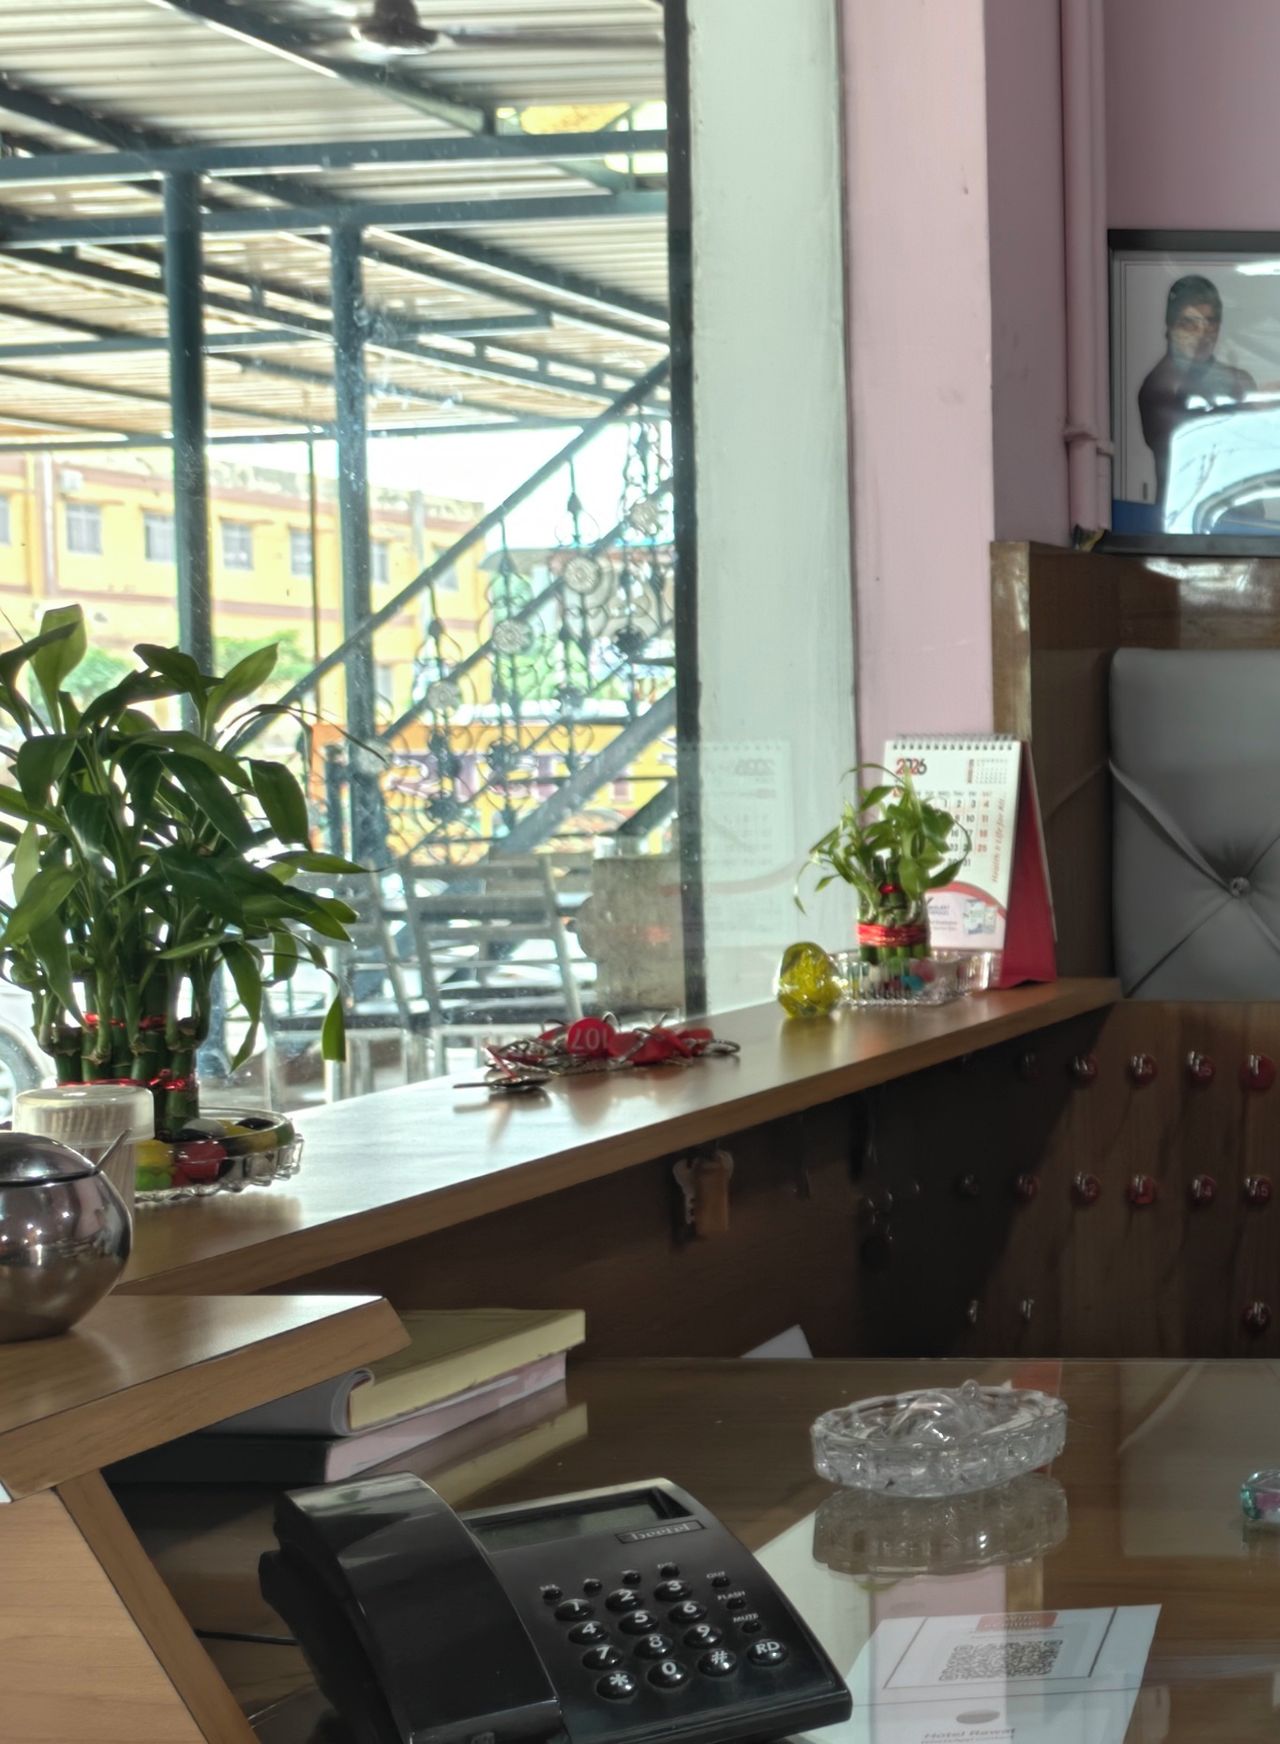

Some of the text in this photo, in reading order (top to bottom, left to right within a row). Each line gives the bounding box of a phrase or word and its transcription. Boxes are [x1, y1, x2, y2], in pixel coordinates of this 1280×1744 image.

[619, 1589, 635, 1601] 2
[668, 1579, 682, 1592] 3
[717, 1590, 746, 1601] FLASH
[582, 1602, 697, 1635] 4 5 6
[732, 1612, 760, 1624] MUTE
[597, 1625, 781, 1660] 7 8 9 RD
[661, 1661, 677, 1676] 0
